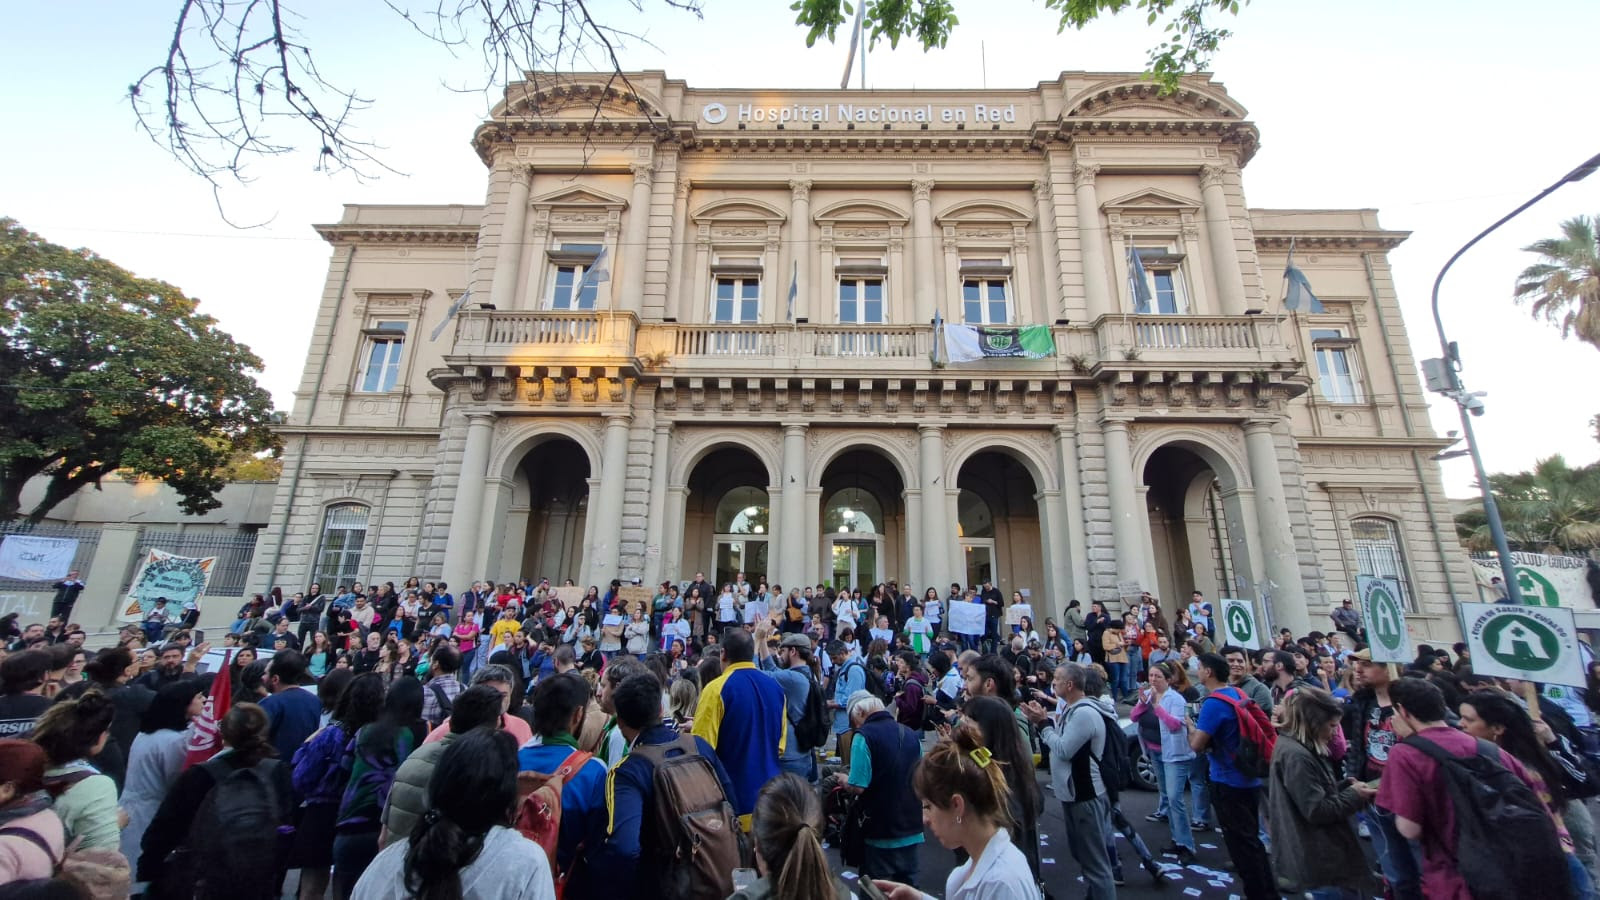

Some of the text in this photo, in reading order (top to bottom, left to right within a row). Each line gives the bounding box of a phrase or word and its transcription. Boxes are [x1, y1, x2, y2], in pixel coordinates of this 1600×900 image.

[738, 104, 1016, 124] Hospital Nacional en Red
[1495, 606, 1525, 614] SALUD
